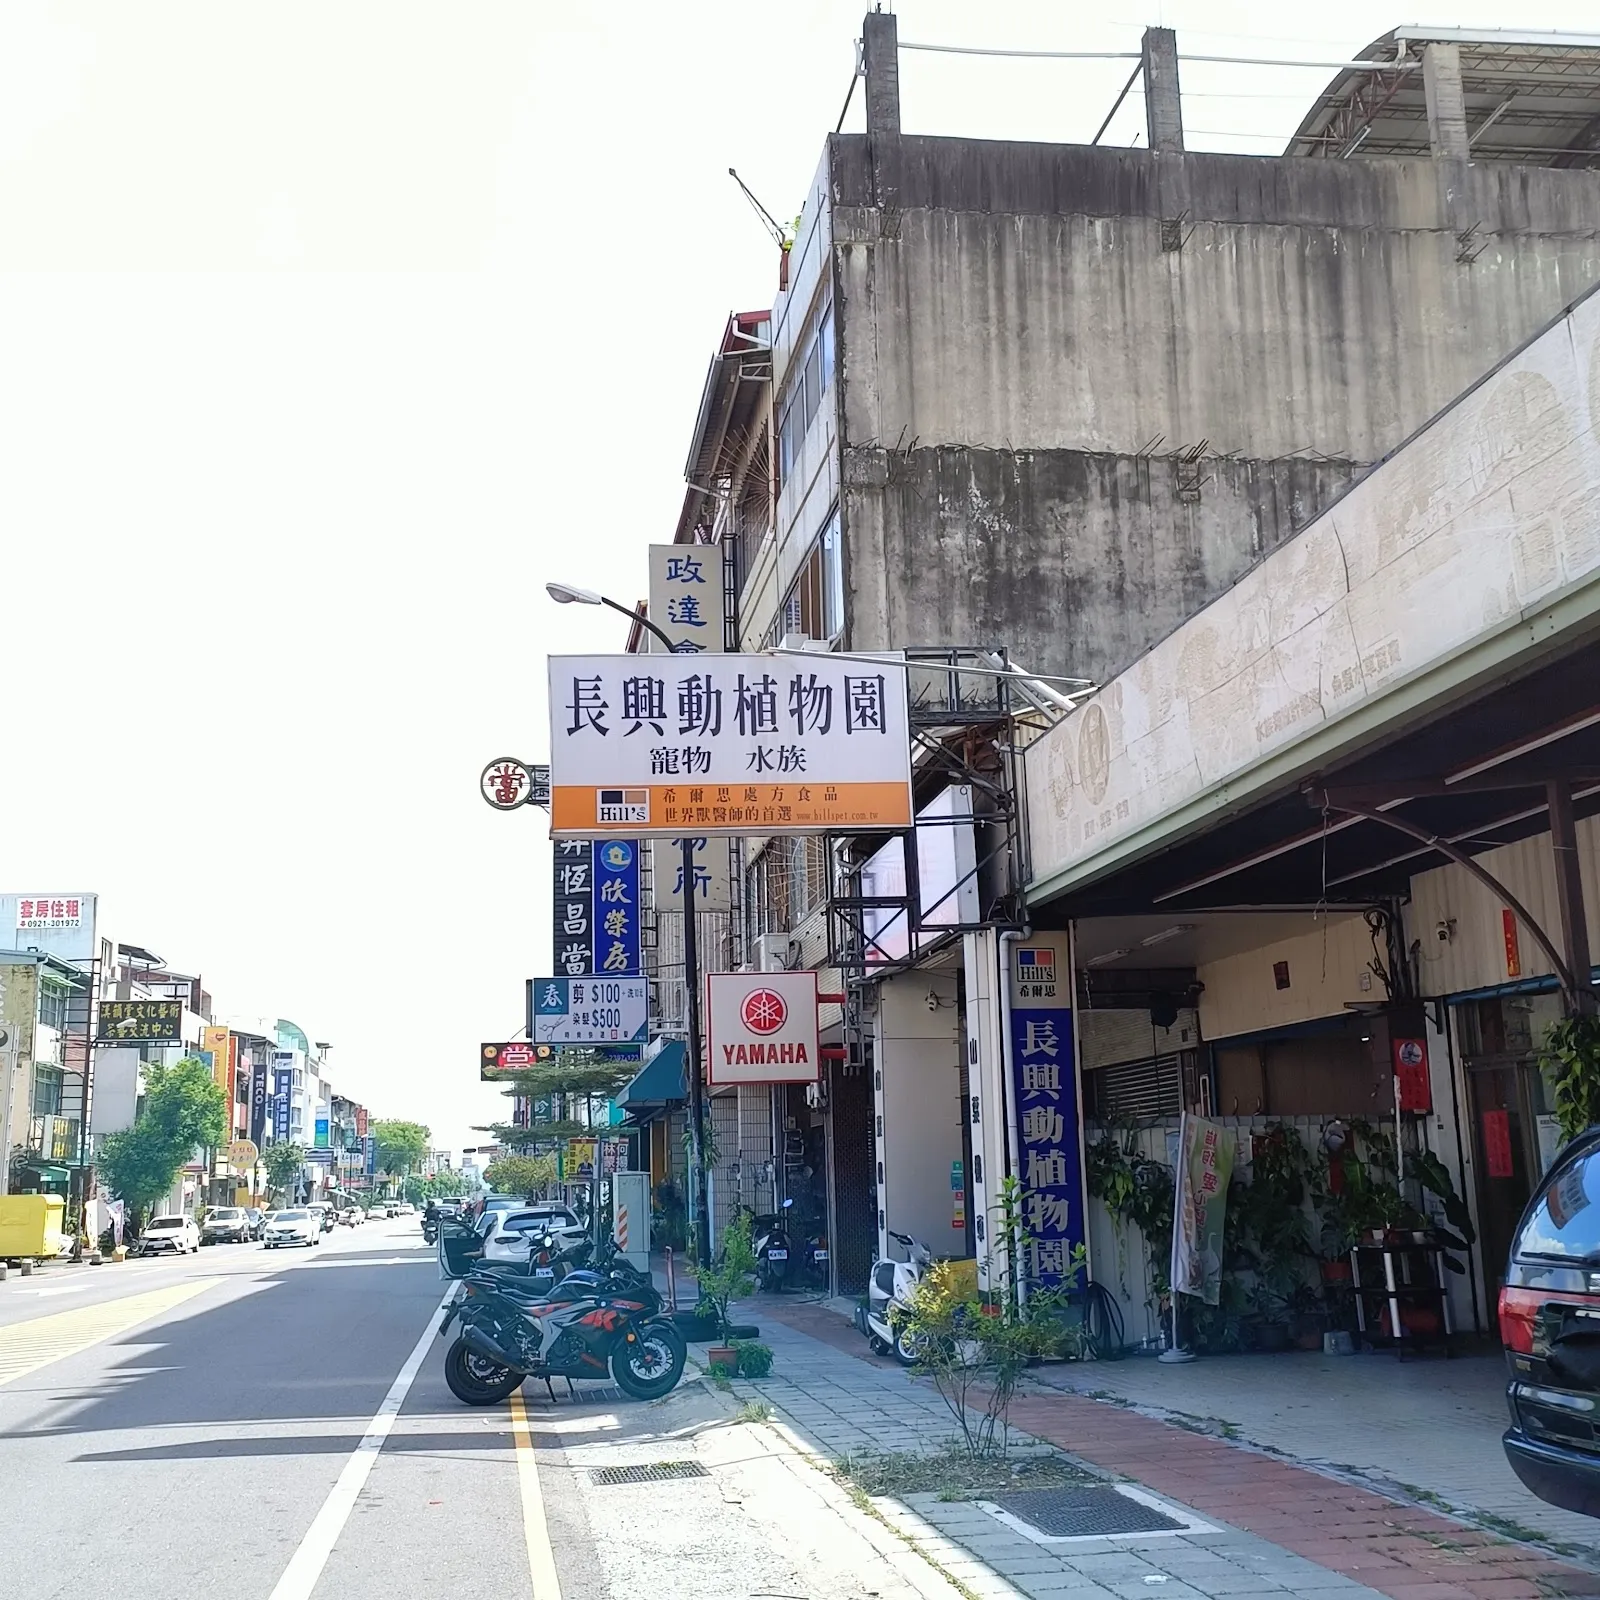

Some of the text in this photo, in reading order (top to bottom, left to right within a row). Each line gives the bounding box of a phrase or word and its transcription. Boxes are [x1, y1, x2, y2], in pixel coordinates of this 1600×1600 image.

[565, 673, 887, 737] 長興動植物園
[650, 744, 807, 775] 寵物 水族
[488, 764, 526, 803] 當
[663, 786, 838, 803] 希爾思處方食品
[665, 806, 792, 823] 世界獸醫師的首選
[20, 900, 79, 919] 套房住租
[27, 919, 80, 928] 0921-301972
[601, 878, 632, 970] 欣榮房
[1020, 966, 1054, 980] Hill's
[540, 983, 563, 1008] 春
[572, 984, 584, 1004] 剪
[592, 983, 620, 1004] $100
[572, 1008, 621, 1029] 染髮 $500
[722, 1043, 808, 1065] YAMAHA
[255, 1072, 265, 1105] TECO
[1019, 1019, 1072, 1278] 長興動植物園
